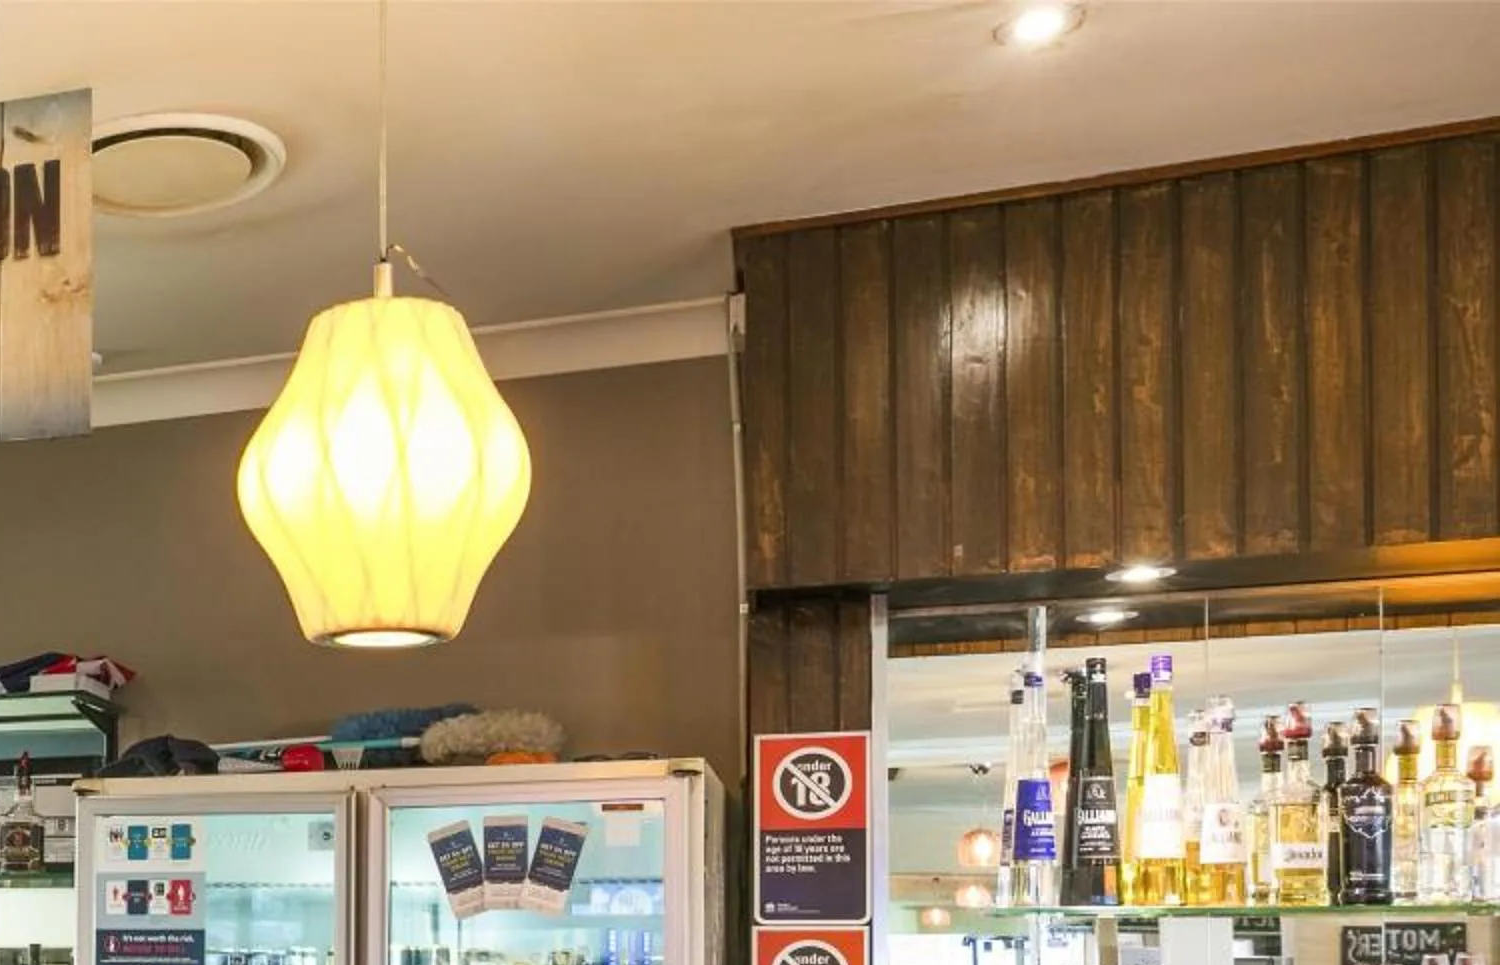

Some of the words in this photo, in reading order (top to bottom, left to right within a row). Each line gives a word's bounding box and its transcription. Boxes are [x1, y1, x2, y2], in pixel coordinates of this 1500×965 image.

[791, 771, 831, 807] 18
[801, 834, 825, 843] under
[827, 833, 843, 843] the
[781, 854, 823, 865] permitted
[835, 853, 851, 863] this
[785, 864, 797, 875] by
